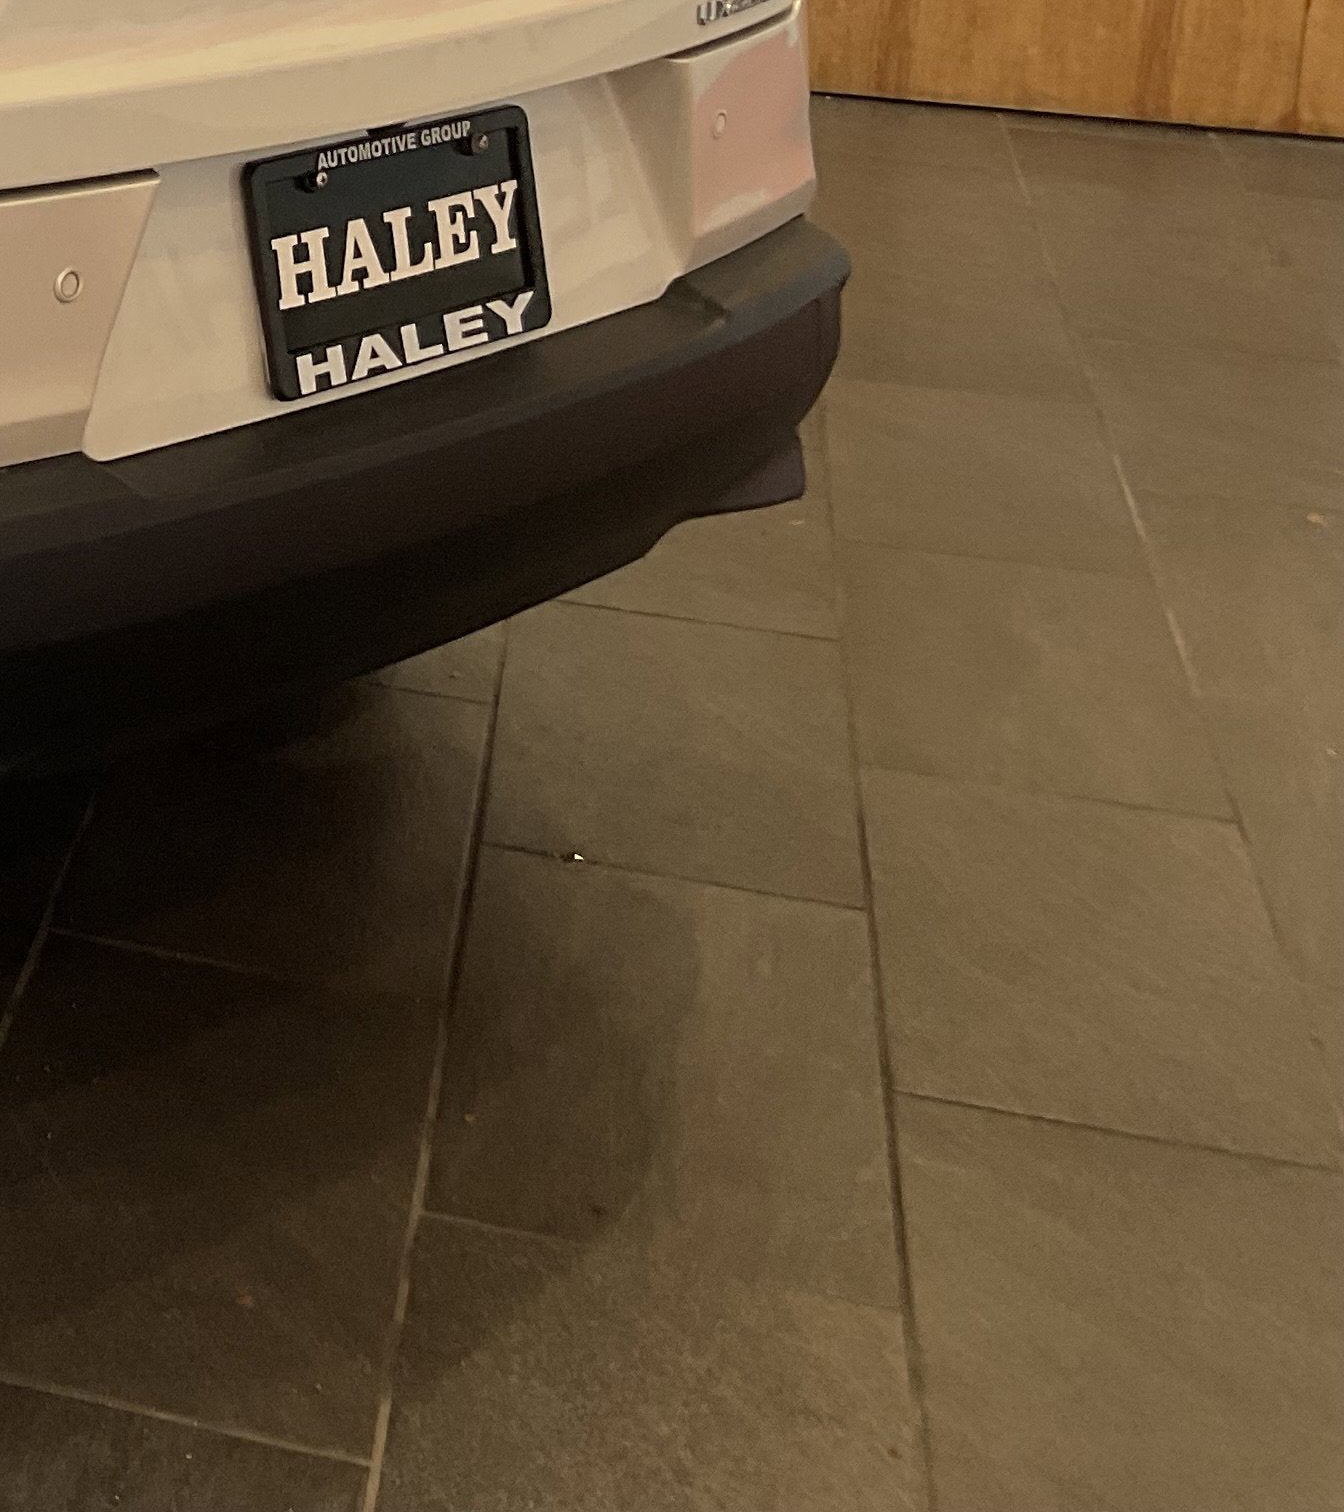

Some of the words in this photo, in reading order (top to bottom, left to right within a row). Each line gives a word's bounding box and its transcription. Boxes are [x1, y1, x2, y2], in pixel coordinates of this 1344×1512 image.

[317, 134, 417, 171] AUTOMOTIVE
[420, 120, 472, 147] GROUP
[271, 179, 518, 311] HALEY
[295, 291, 534, 395] HALEY
